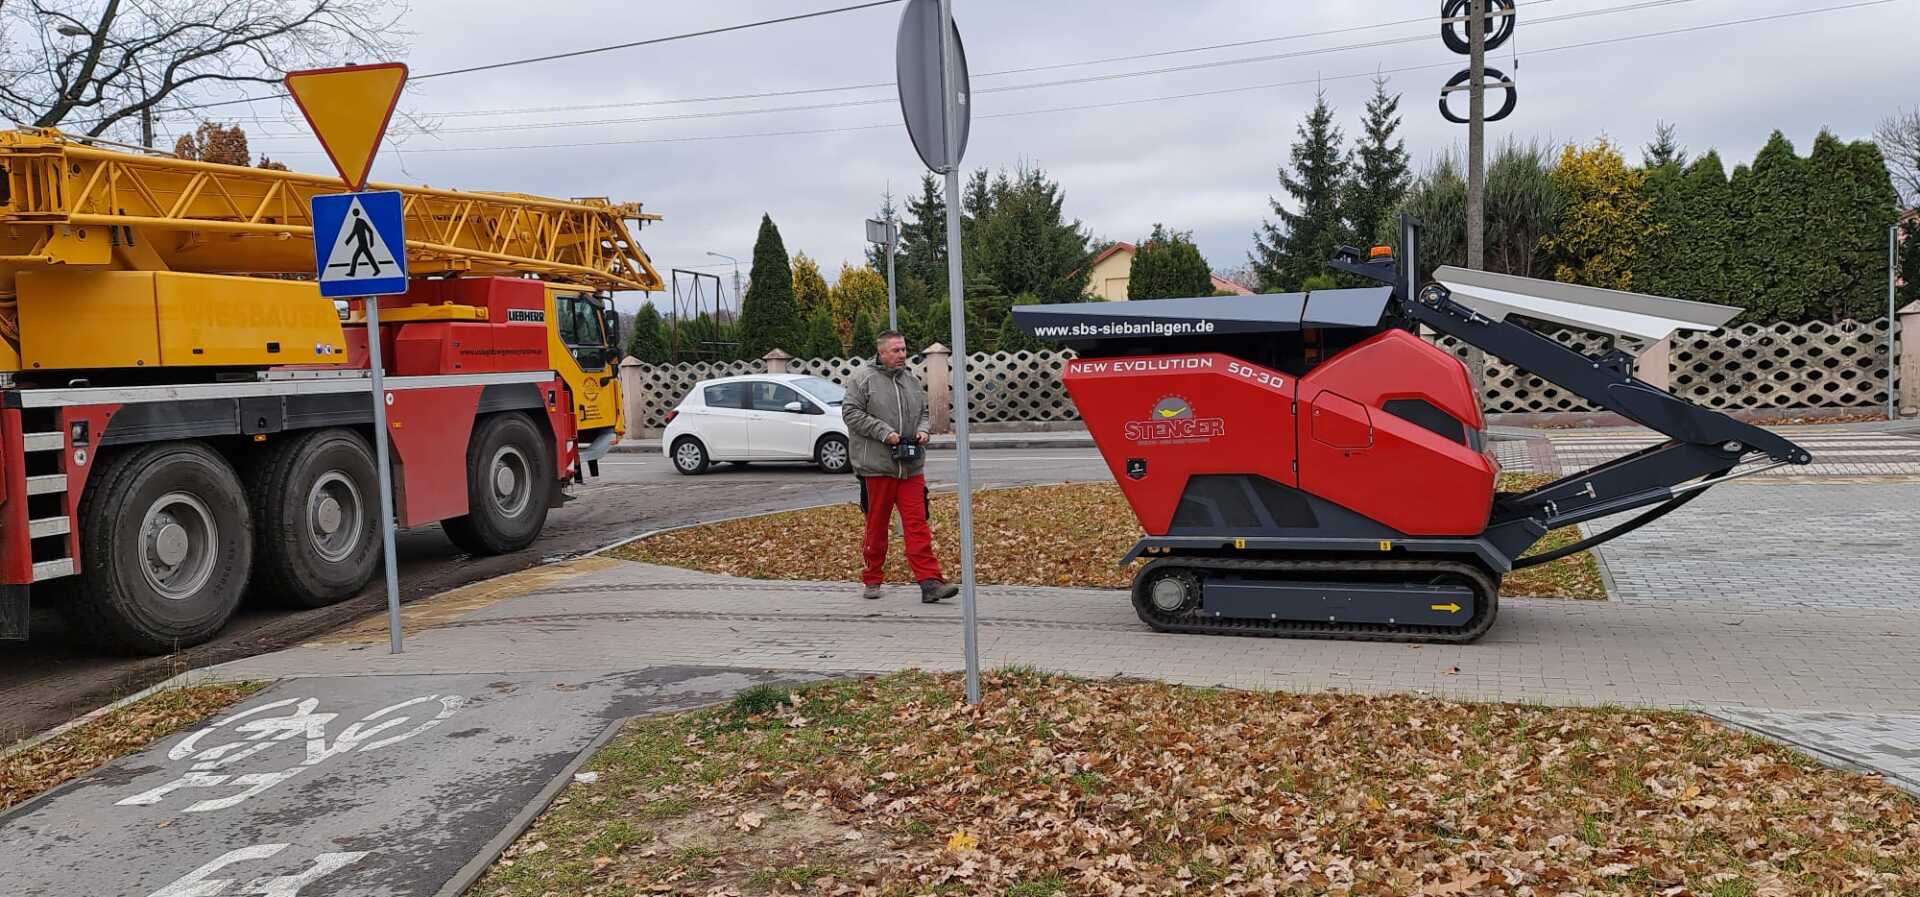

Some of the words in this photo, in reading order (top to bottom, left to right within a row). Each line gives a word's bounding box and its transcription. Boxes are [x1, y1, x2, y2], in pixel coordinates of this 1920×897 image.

[508, 310, 544, 321] LIEBHERR
[1034, 320, 1215, 336] www.sbs-siebanlagen.de
[1070, 361, 1108, 374] NEW
[1113, 357, 1213, 372] EVOLUTION
[1227, 362, 1284, 389] 50-30
[1125, 418, 1225, 440] STENGER
